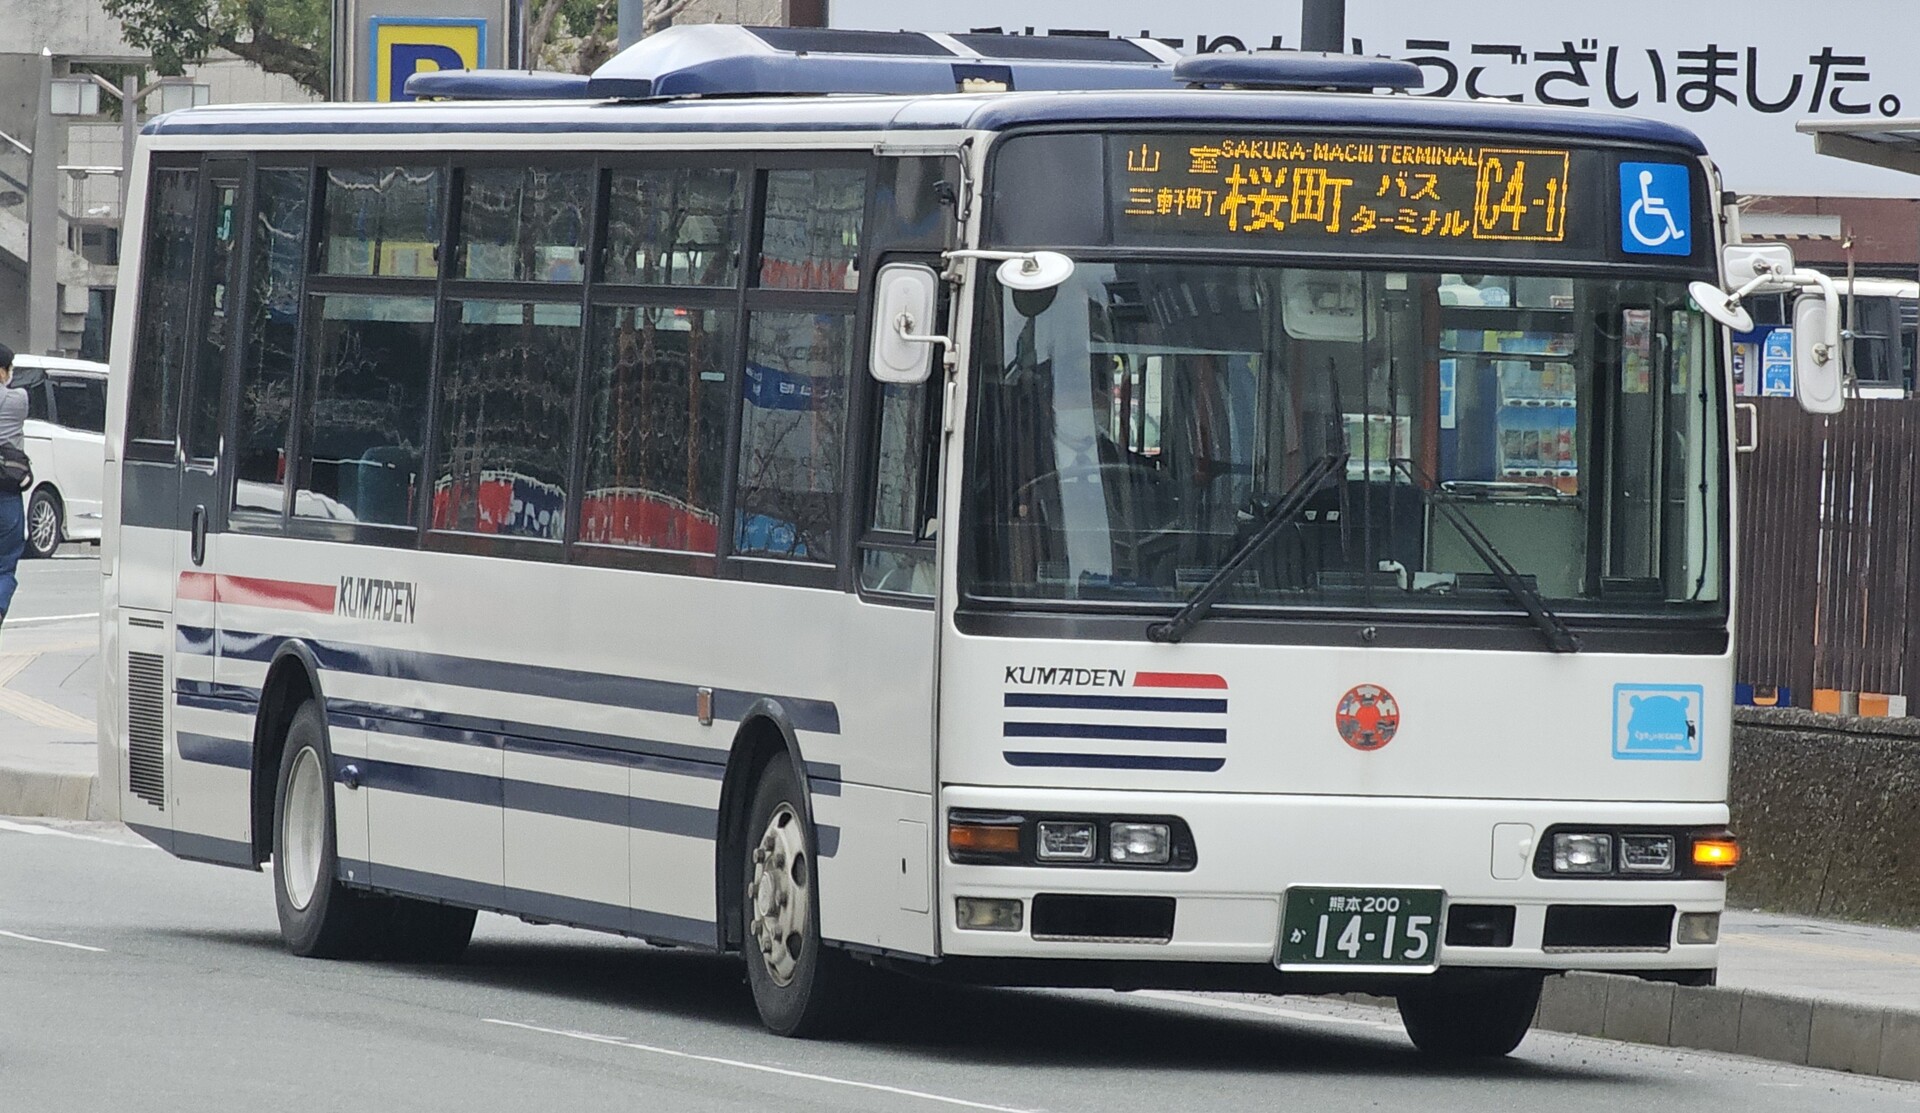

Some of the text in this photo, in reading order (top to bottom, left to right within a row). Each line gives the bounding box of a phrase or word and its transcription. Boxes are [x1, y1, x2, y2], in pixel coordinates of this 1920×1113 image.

[1221, 140, 1477, 166] SAKURA-MACHI TERMINAL
[1479, 157, 1557, 232] C4-1
[1351, 205, 1470, 236] ターミナル
[338, 575, 417, 624] KUMADEN
[1004, 666, 1126, 687] KUMADEN
[1290, 914, 1432, 959] か 14-15
